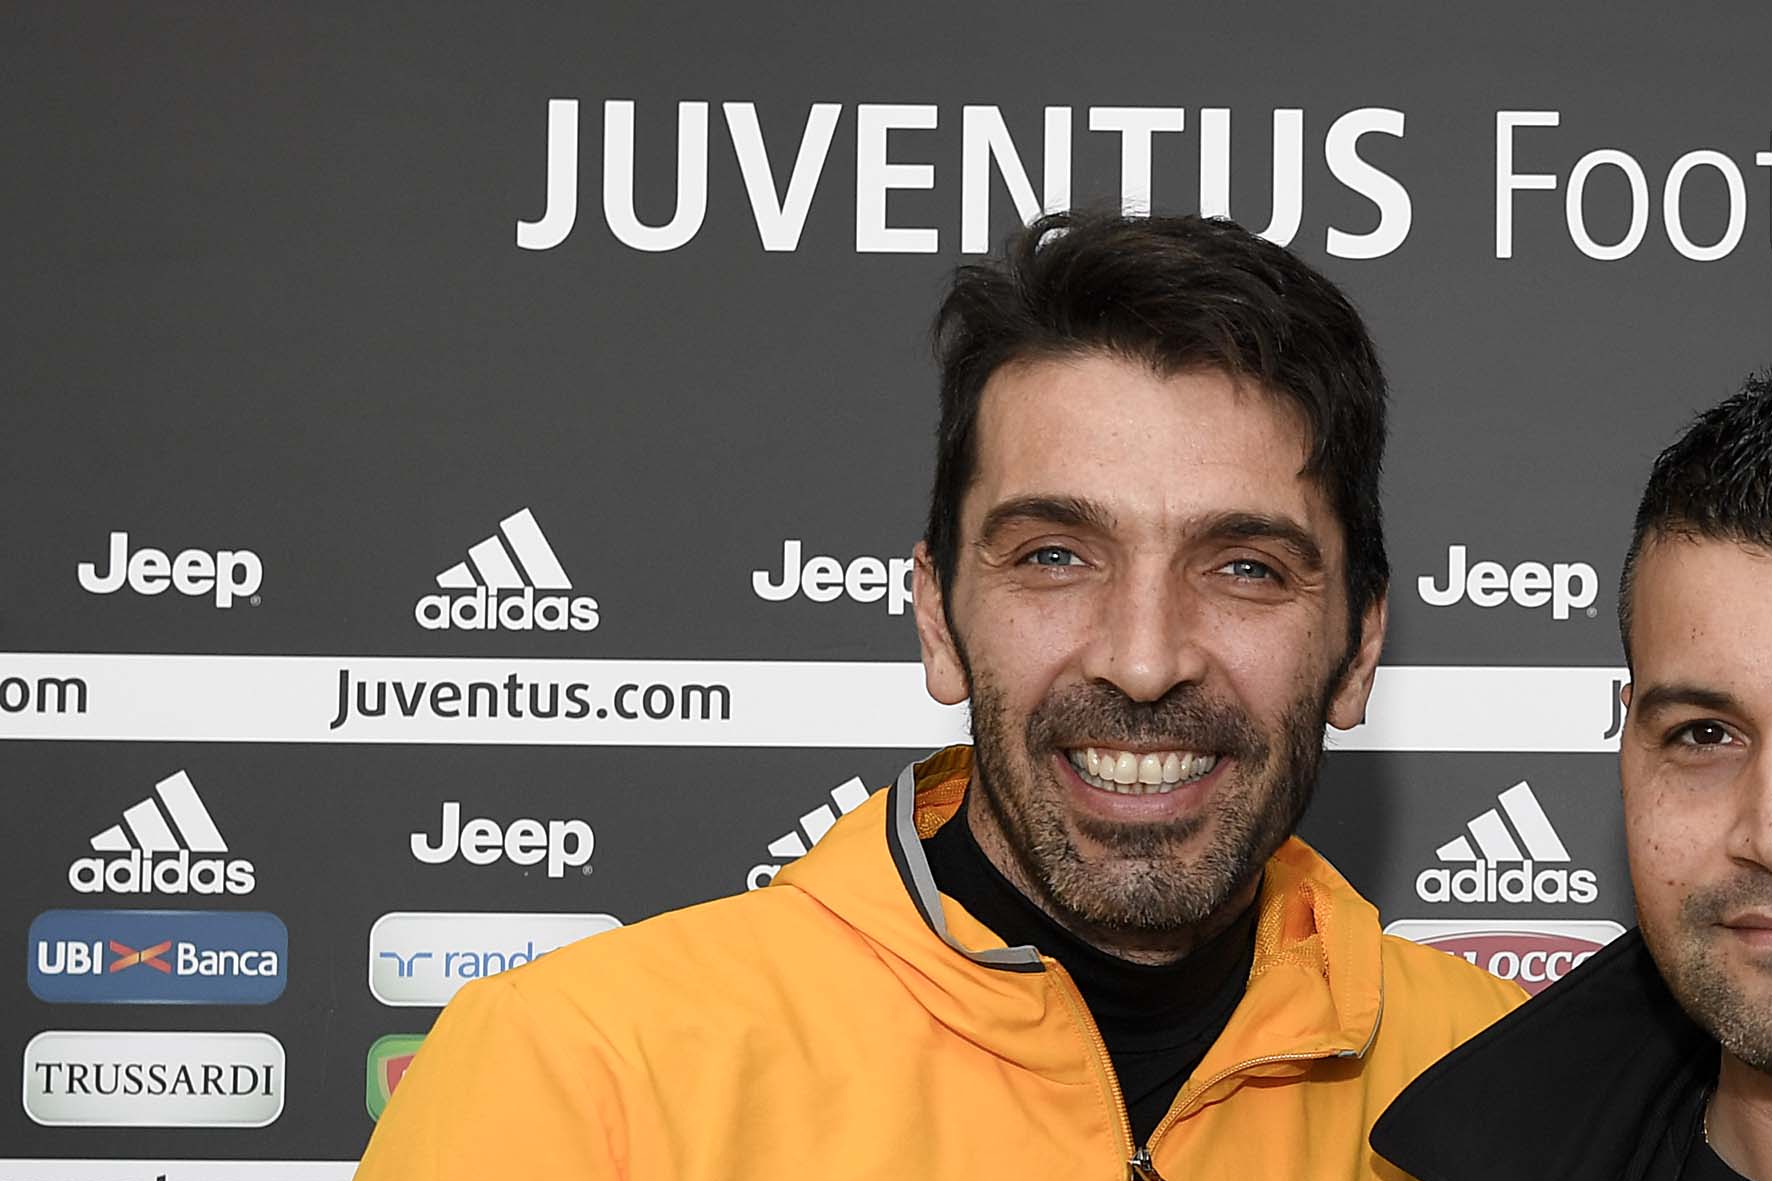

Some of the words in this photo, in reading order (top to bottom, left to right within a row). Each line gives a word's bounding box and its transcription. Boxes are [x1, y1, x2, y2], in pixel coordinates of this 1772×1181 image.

[518, 100, 1411, 259] JUVENTUS
[78, 533, 262, 606] Jeep
[1418, 545, 1598, 619] Jeep
[415, 586, 600, 631] adidas
[330, 669, 732, 730] Juventus.com
[411, 802, 594, 878] Jeep
[68, 850, 256, 895] adidas
[1415, 861, 1598, 904] adidas
[38, 941, 103, 975] UBI
[176, 942, 279, 977] Banca
[35, 1062, 274, 1097] TRUSSARDI
